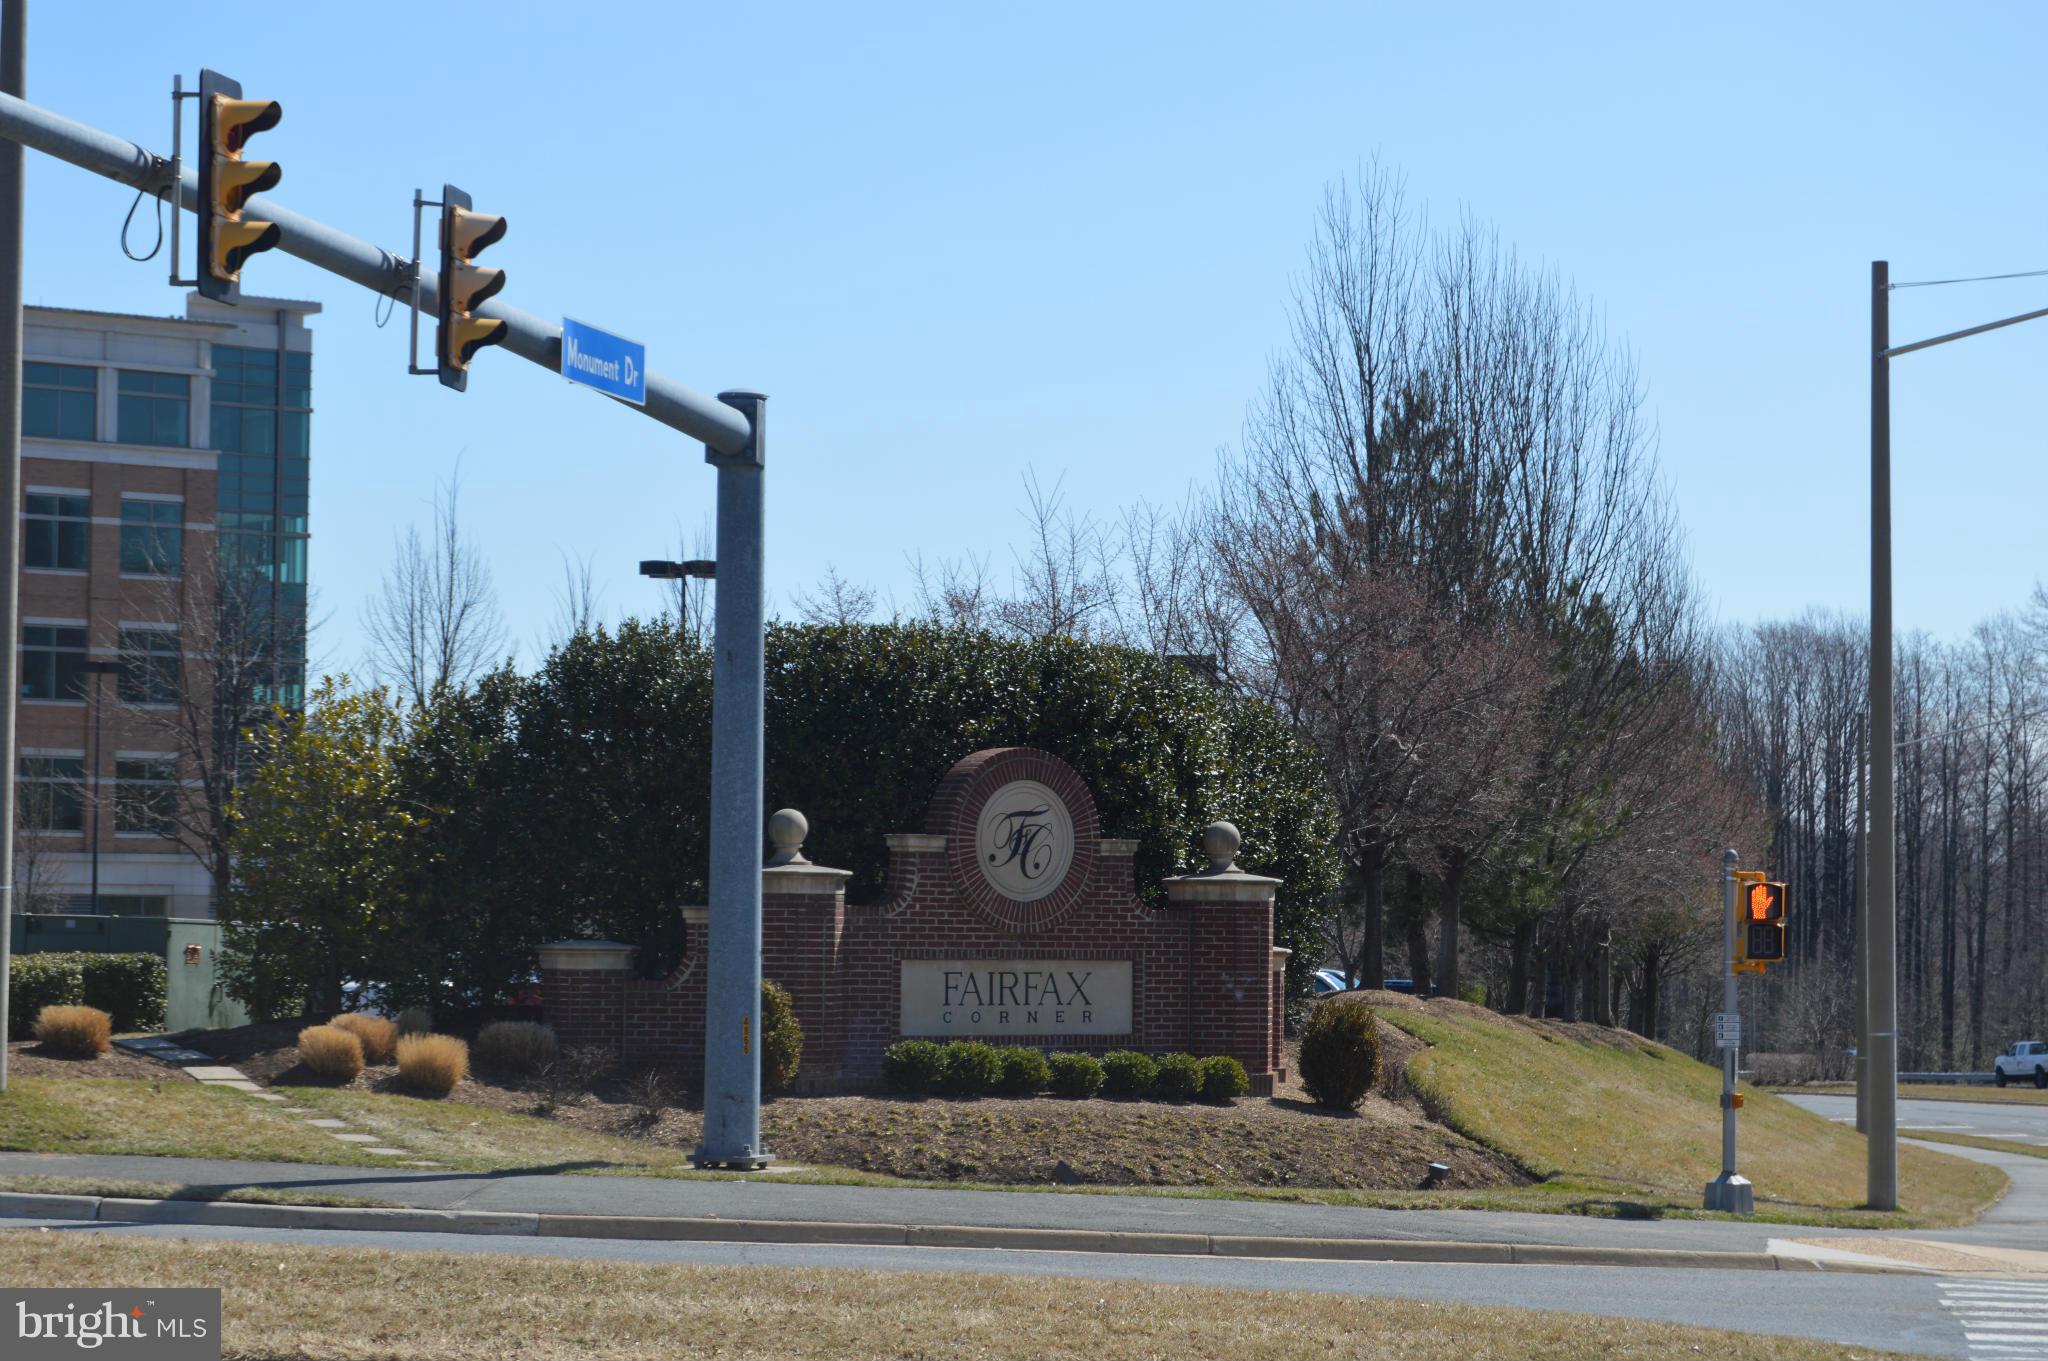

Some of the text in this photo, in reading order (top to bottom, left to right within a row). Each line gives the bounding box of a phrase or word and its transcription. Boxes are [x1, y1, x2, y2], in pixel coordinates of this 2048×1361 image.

[567, 336, 639, 388] Monument Dr
[942, 971, 1093, 1006] FAIRFAX
[942, 1011, 1093, 1024] CORNER
